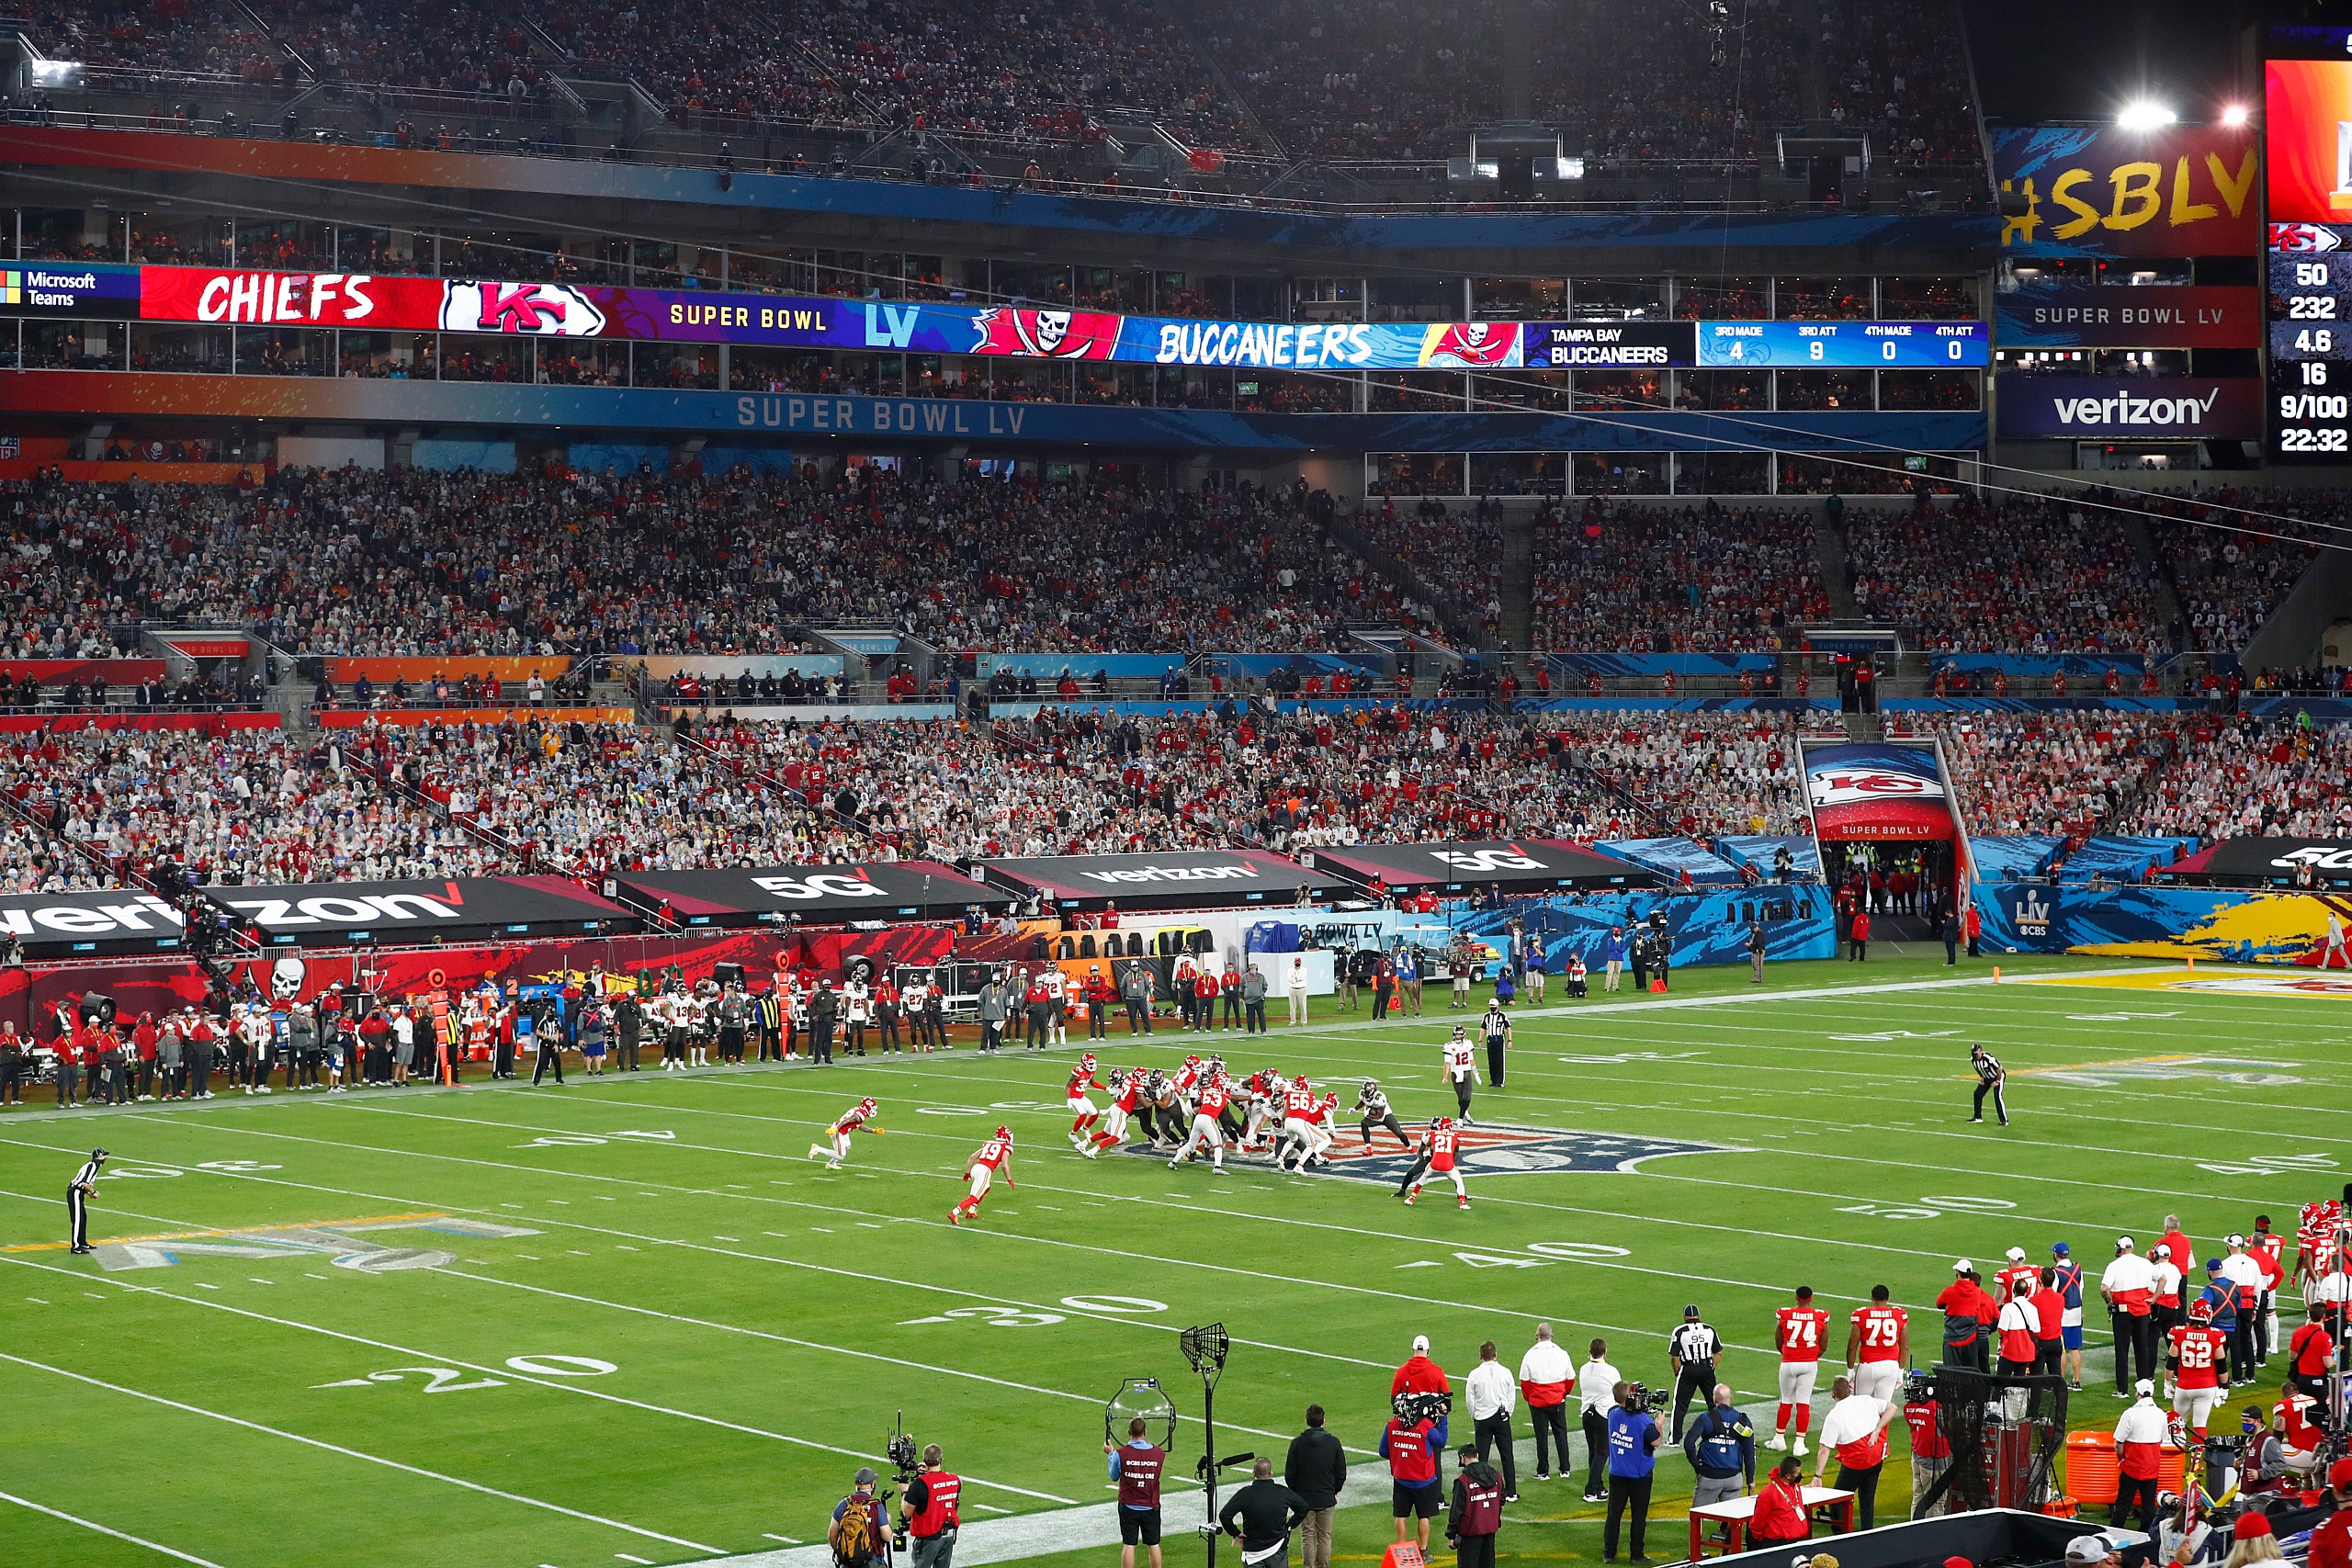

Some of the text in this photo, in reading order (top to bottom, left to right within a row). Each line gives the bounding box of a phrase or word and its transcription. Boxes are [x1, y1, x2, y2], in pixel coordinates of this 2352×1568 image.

[2001, 147, 2258, 247] #SBLV
[28, 271, 96, 291] Microsoft
[2297, 264, 2327, 287] 50
[28, 289, 74, 307] Teams
[197, 275, 375, 322] CHIEFS
[2035, 307, 2223, 324] SUPER BOWL LV
[2290, 297, 2336, 319] 232
[670, 303, 921, 348] SUPER BOWL LV
[1715, 326, 1763, 337] 3RD MADE
[1799, 326, 1838, 337] 3RD ATT
[1865, 326, 1912, 337] 4TH MADE
[1935, 326, 1973, 337] 4TH ATT
[1155, 322, 1373, 367] BUCCANEERS
[1551, 329, 1623, 343] TAMPA BAY
[2294, 329, 2332, 352] 4.6
[1551, 345, 1668, 364] BUCCANEERS
[1729, 341, 1744, 360] 4
[1810, 341, 1825, 360] 9
[1883, 341, 1896, 360] 0
[1949, 341, 1962, 359] 0
[2301, 362, 2326, 386] 16
[738, 396, 1025, 434] SUPER BOWL LV
[2053, 390, 2201, 424] verizon
[2280, 394, 2347, 420] 9/100
[2281, 429, 2347, 451] 22:32
[487, 690, 494, 698] 12
[435, 731, 445, 739] 12
[1247, 752, 1257, 761] 87
[811, 770, 823, 780] 12
[1329, 834, 1336, 842] 12
[1842, 826, 1929, 835] SUPER BOWL LV
[1298, 836, 1306, 844] 12
[563, 861, 571, 869] 12
[1430, 850, 1549, 871] 5G
[1080, 865, 1259, 885] verizon
[751, 874, 889, 898] 5G
[1315, 923, 1358, 941] BOWL
[1363, 921, 1382, 939] LV
[2028, 926, 2046, 935] CBS
[506, 979, 518, 995] 2
[909, 995, 922, 1005] 27
[676, 1007, 687, 1017] 13
[255, 1025, 264, 1036] 11
[1455, 1052, 1469, 1066] 12
[1201, 1093, 1222, 1108] 53
[1290, 1095, 1310, 1111] 56
[1435, 1136, 1453, 1154] 21
[1834, 1195, 2018, 1220] 50
[1452, 1242, 1632, 1269] 40
[944, 1295, 1168, 1327] 30
[1691, 1335, 1704, 1343] 95
[1787, 1322, 1817, 1348] 74
[1866, 1319, 1898, 1347] 79
[2187, 1332, 2208, 1341] REITER
[2181, 1340, 2212, 1368] 62
[368, 1355, 618, 1394] 20
[1611, 1431, 1634, 1442] FILMS
[1611, 1438, 1633, 1449] CAMERA
[1394, 1442, 1418, 1450] CAMERA
